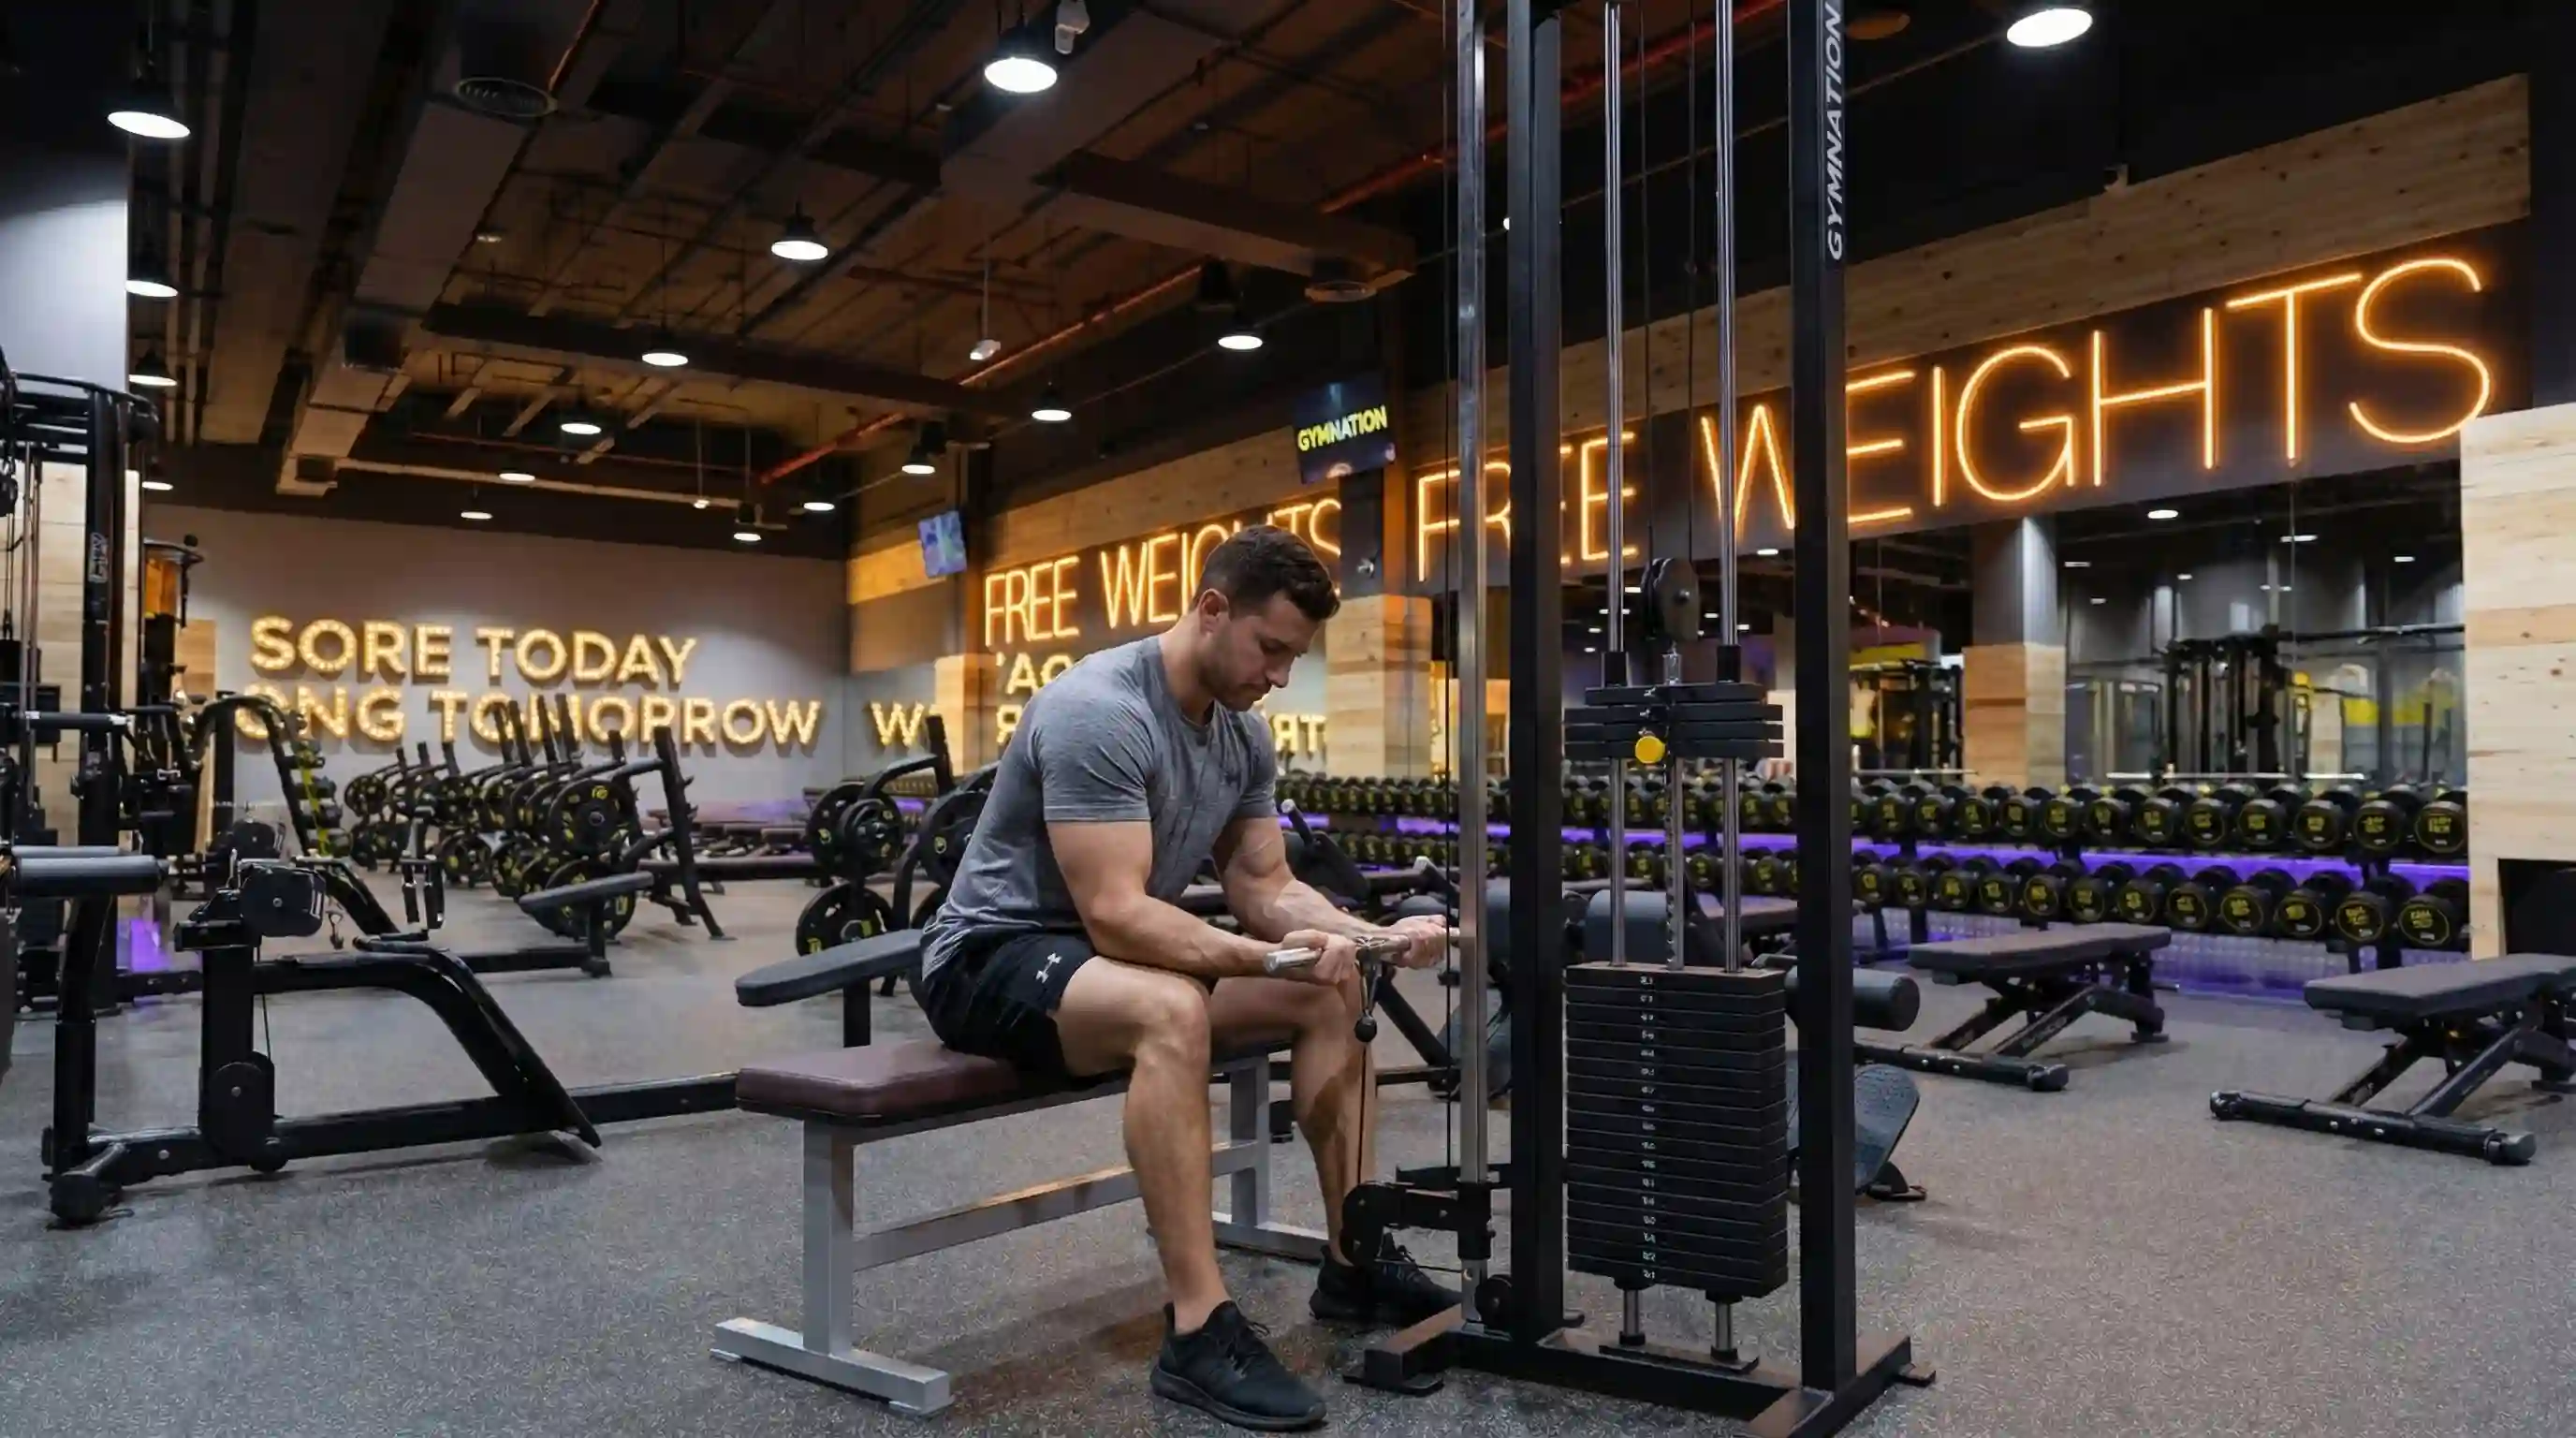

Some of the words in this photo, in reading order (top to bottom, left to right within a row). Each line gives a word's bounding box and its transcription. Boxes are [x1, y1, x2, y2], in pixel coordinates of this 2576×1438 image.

[1825, 0, 1843, 260] GYMNATION
[1297, 404, 1388, 451] GYMNATION
[1418, 432, 1639, 582] FRE
[1700, 257, 2491, 537] WEIGHTS
[986, 556, 1079, 647] FREE
[251, 616, 453, 676] SORE
[477, 627, 697, 683] TODAY
